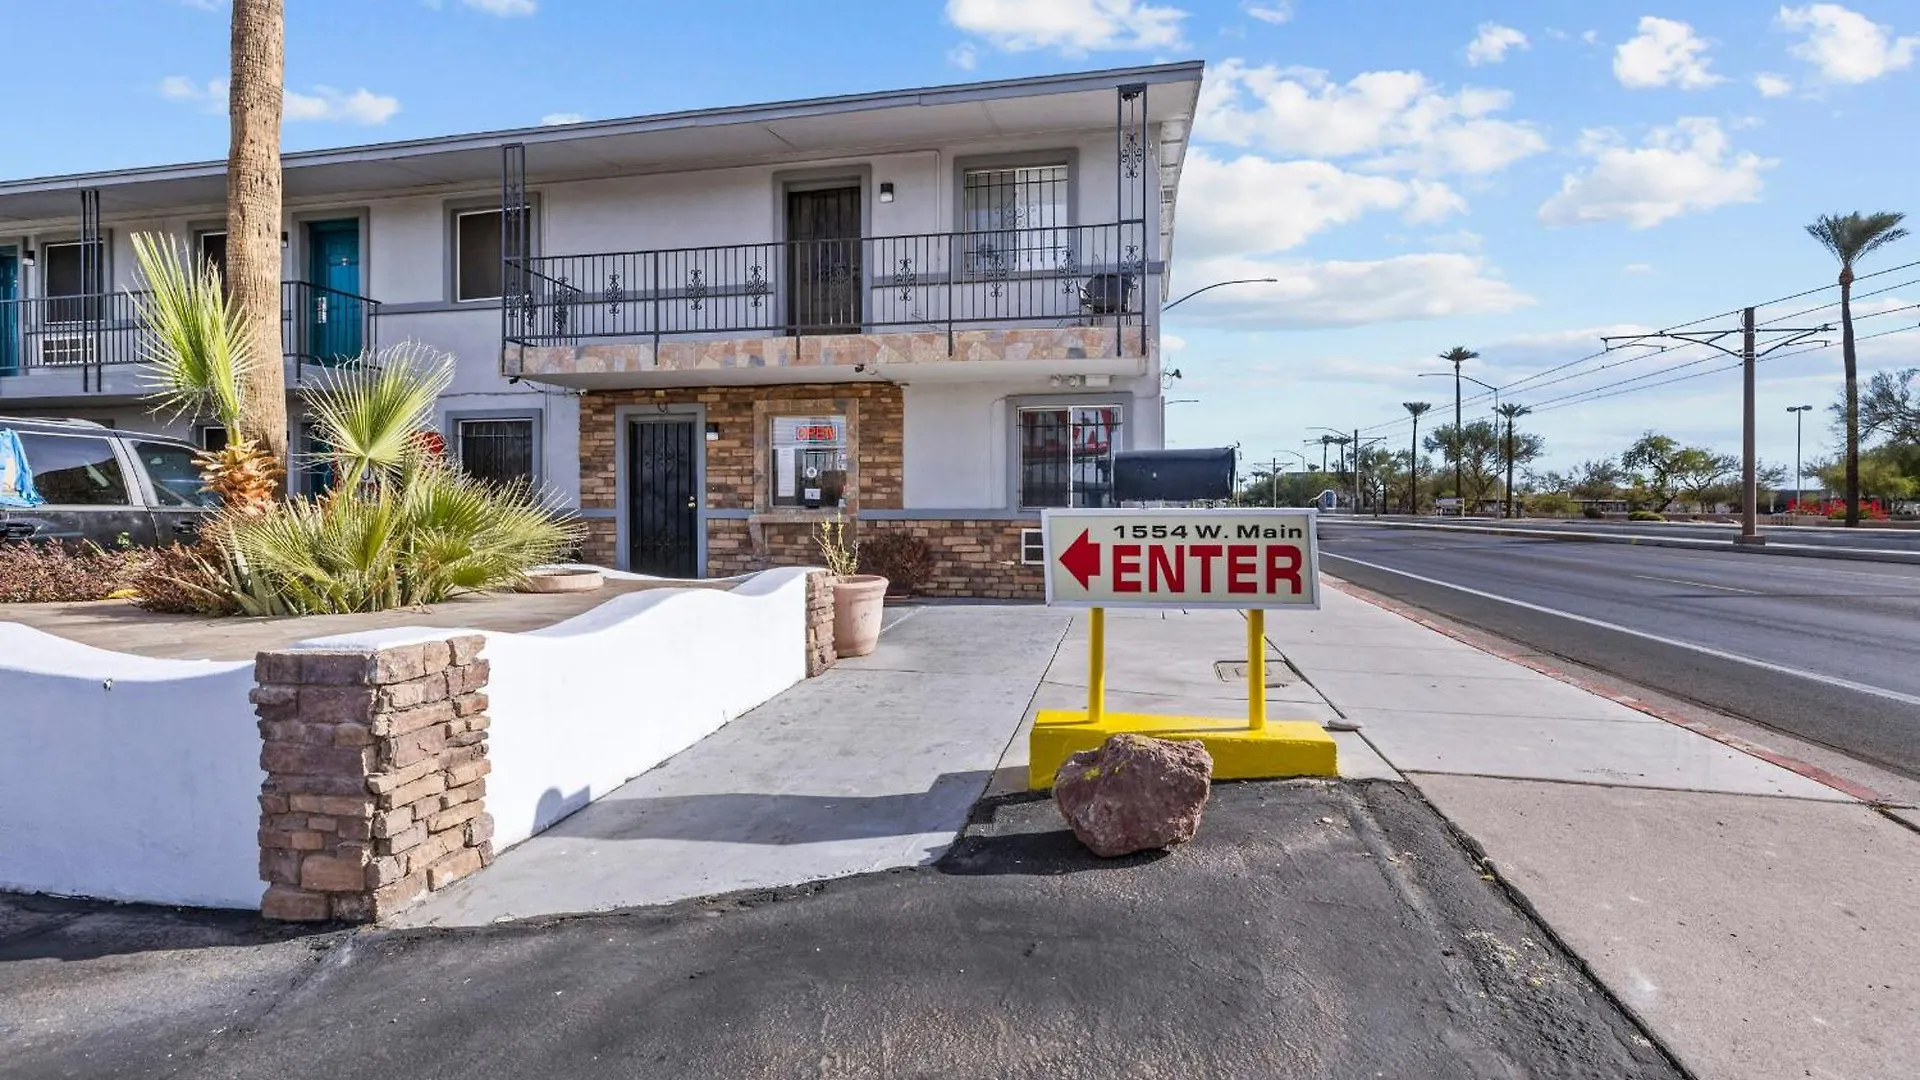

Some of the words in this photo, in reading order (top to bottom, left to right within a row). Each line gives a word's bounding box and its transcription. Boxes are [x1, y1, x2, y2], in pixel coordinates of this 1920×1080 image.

[797, 426, 834, 441] OPEN
[1113, 524, 1188, 539] 1554
[1195, 524, 1229, 539] W.
[1236, 524, 1303, 539] Main
[1112, 544, 1303, 595] ENTER
